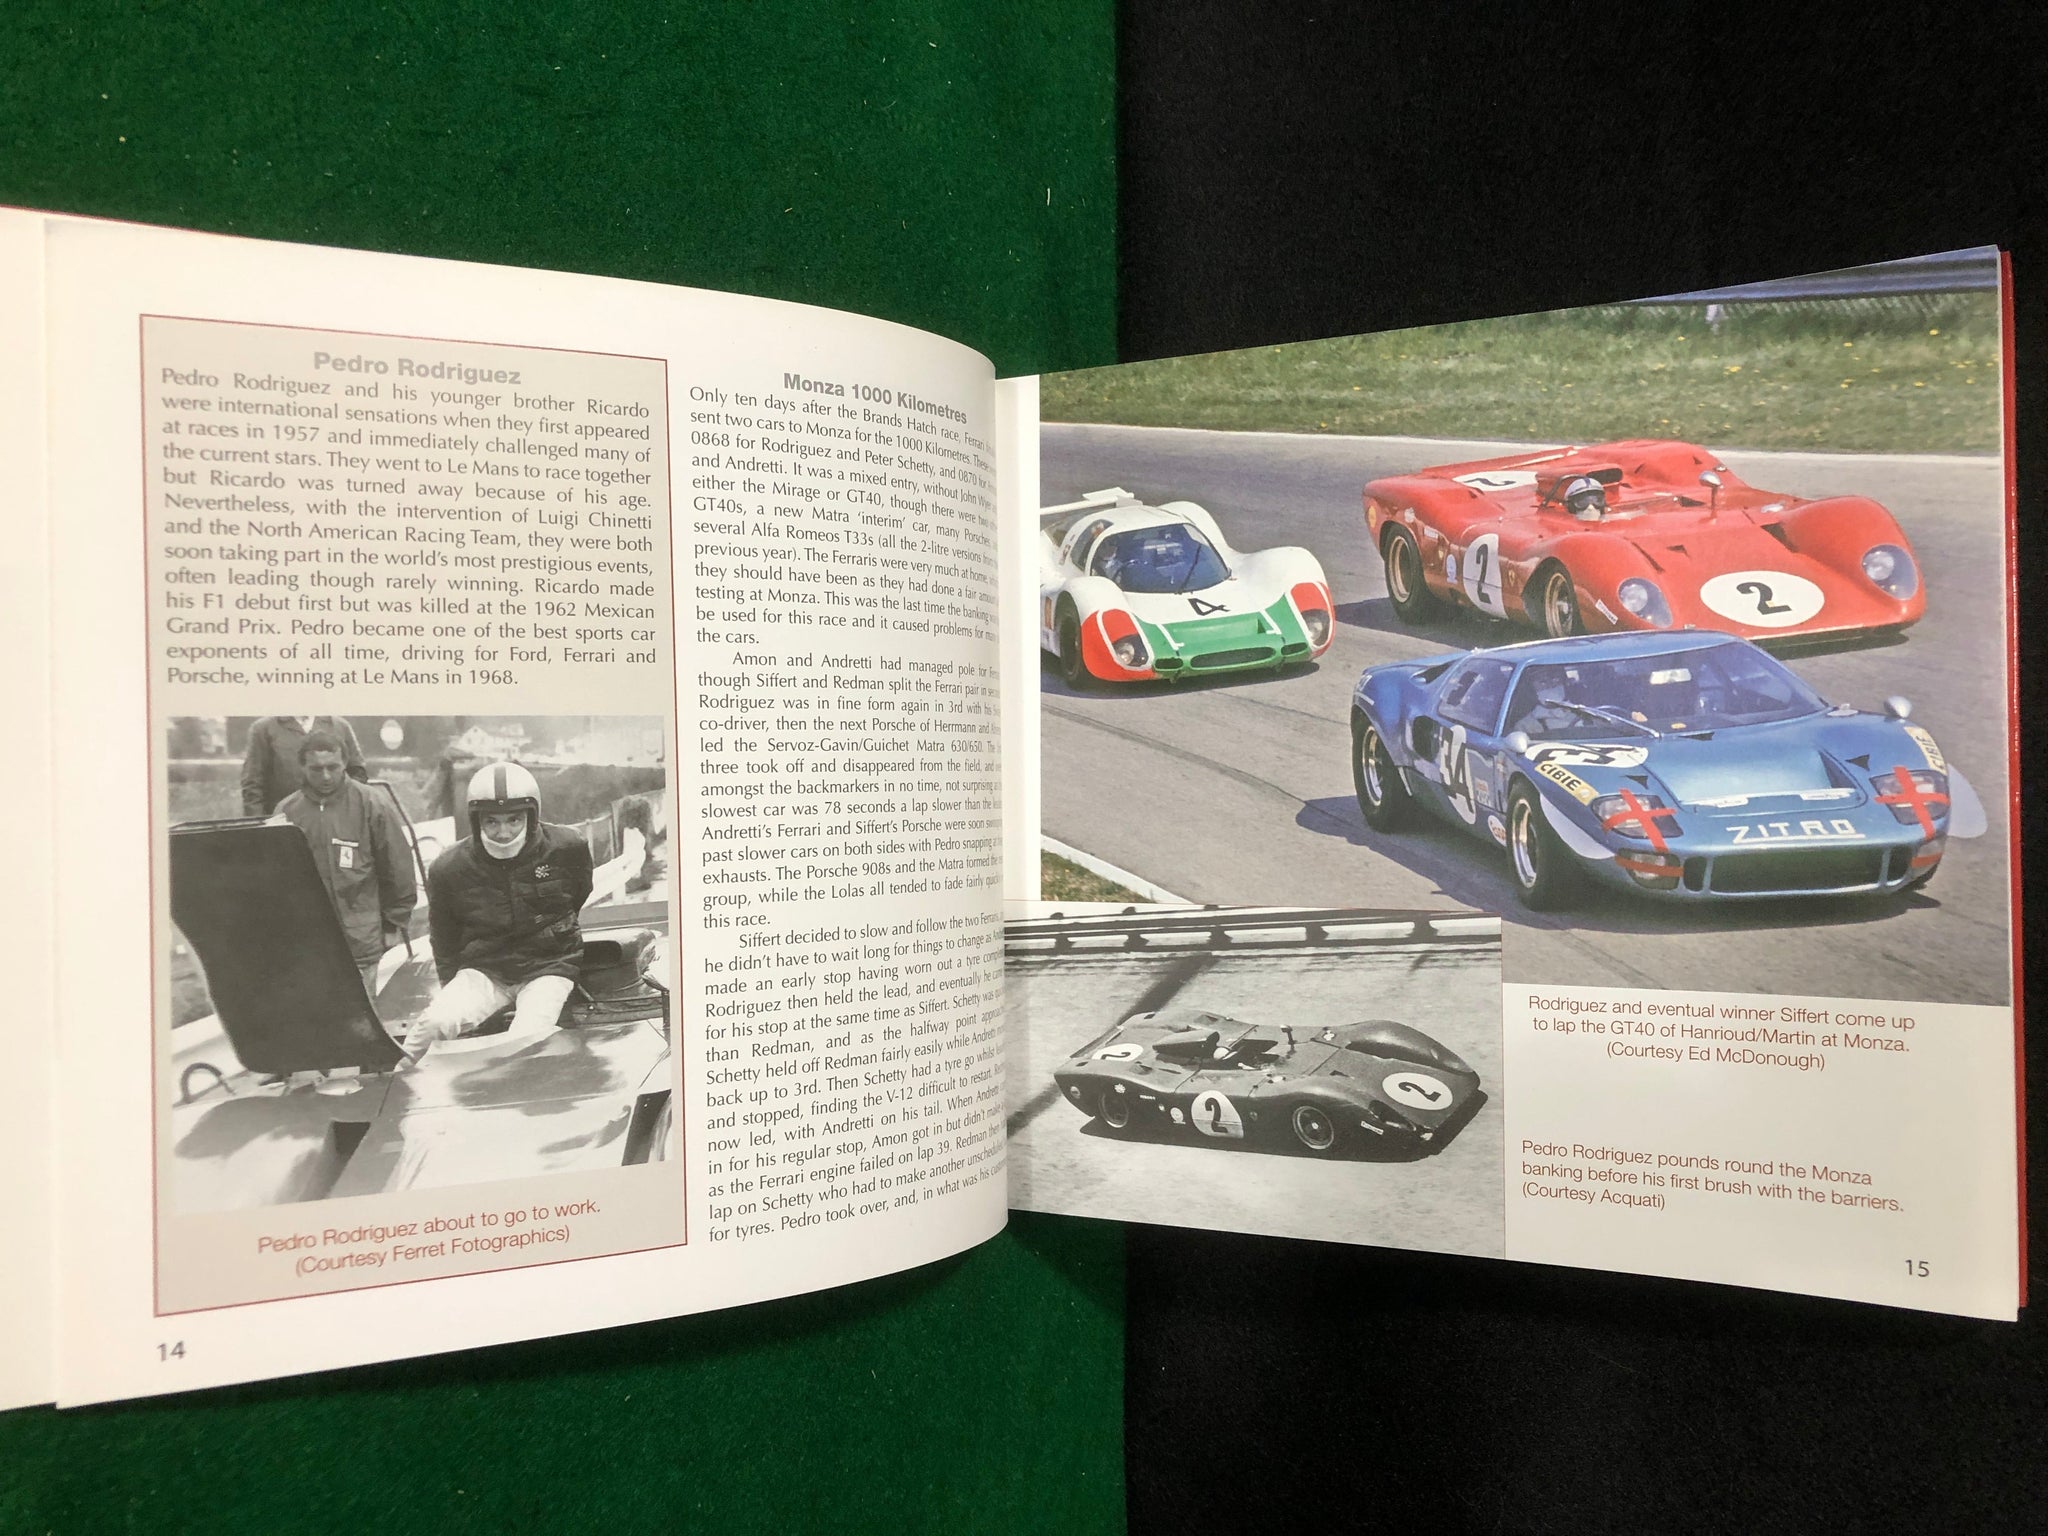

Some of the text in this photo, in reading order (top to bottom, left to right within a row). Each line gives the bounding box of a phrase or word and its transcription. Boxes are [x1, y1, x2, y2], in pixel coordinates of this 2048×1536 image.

[313, 351, 521, 385] Pedro Rodriguez
[161, 367, 650, 418] Pedro Rodriguez and his younger brother Ricardo
[783, 372, 967, 424] Monza 1000 Kilometres
[162, 441, 652, 487] the current stars. They went to Le Mans to race together
[691, 430, 730, 447] 0868
[736, 433, 756, 450] for
[762, 437, 832, 460] Rodriguez
[836, 447, 860, 462] and
[865, 450, 894, 467] Peter
[897, 455, 936, 478] Schetty,
[939, 466, 956, 479] and
[958, 469, 978, 482] 0870
[164, 492, 652, 530] Nevertheless, with the intervention of Luigi Chinetti
[693, 496, 747, 516] GT40s,
[756, 504, 765, 515] a
[774, 506, 804, 518] new
[812, 506, 850, 523] Matra
[912, 521, 930, 535] car,
[935, 525, 960, 541] many
[164, 566, 655, 597] often leading though rarely winning. Ricardo made
[1476, 543, 1492, 605] 2
[1188, 598, 1230, 616] 4
[1736, 581, 1792, 615] 2
[696, 627, 760, 644] the cars.
[167, 666, 518, 690] Porsche, winning at Le Mans in 1968.
[701, 802, 757, 819] slowest
[763, 805, 786, 817] car
[791, 805, 819, 815] was
[824, 801, 841, 815] 78
[847, 798, 896, 814] seconds
[900, 802, 907, 812] a
[912, 797, 928, 816] lap
[932, 797, 962, 811] slower
[964, 797, 981, 810] than
[703, 913, 771, 929] this race.
[706, 1000, 782, 1019] Rodriguez
[787, 994, 818, 1010] then
[824, 988, 853, 1006] held
[858, 987, 878, 1002] the
[883, 982, 911, 999] lead,
[916, 978, 935, 995] and
[939, 971, 981, 991] eventually
[1529, 995, 1916, 1032] Rodriguez and eventual winner Siffert come up
[1532, 1017, 1910, 1052] to lap the GT40 of Hanrioud/Martin at Monza.
[1607, 1041, 1825, 1072] (Courtesy Ed McDonough)
[1398, 1081, 1442, 1102] 2
[1205, 1097, 1228, 1133] 2
[1522, 1139, 1873, 1186] Pedro Rodriguez pounds round the Monza
[709, 1226, 731, 1242] for
[735, 1222, 775, 1242] tyres.
[781, 1211, 821, 1231] Pedro
[825, 1203, 855, 1222] took
[859, 1200, 889, 1215] over,
[894, 1189, 919, 1208] and,
[923, 1187, 933, 1201] in
[936, 1179, 960, 1196] what
[962, 1174, 978, 1188] was
[979, 1167, 990, 1181] his
[1522, 1160, 1904, 1213] banking before his first brush with the barriers.
[1522, 1181, 1665, 1212] (Courtesy Acquati)
[257, 1198, 601, 1254] Pedro Rodriguez about to go to work.
[295, 1224, 570, 1278] (Courtesy Ferret Fotographics)
[1904, 1259, 1930, 1278] 15
[156, 1340, 187, 1363] 14
